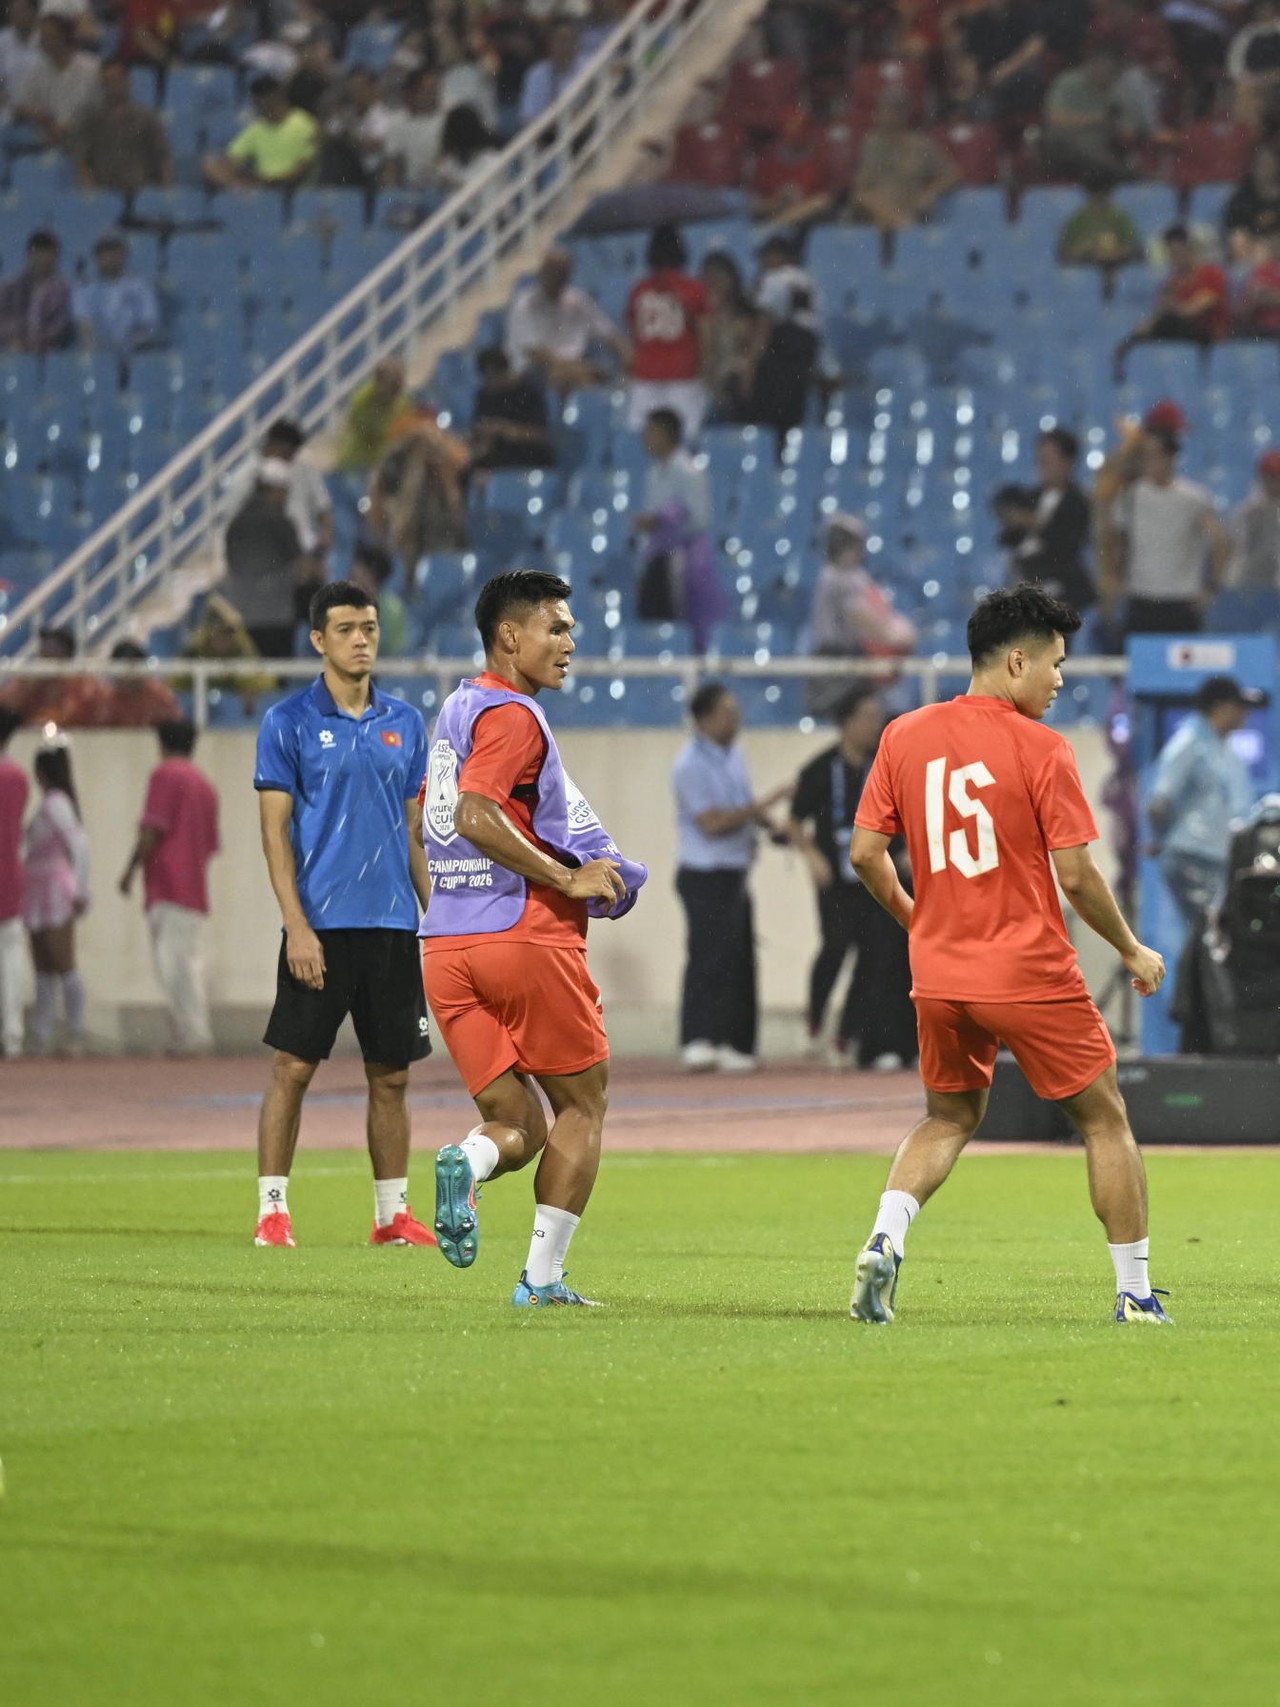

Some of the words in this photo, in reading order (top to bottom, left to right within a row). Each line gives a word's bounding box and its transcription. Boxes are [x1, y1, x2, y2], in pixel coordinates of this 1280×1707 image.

[925, 756, 997, 879] 15
[427, 857, 494, 873] CHAMPIONSHIP
[468, 872, 493, 887] 2026
